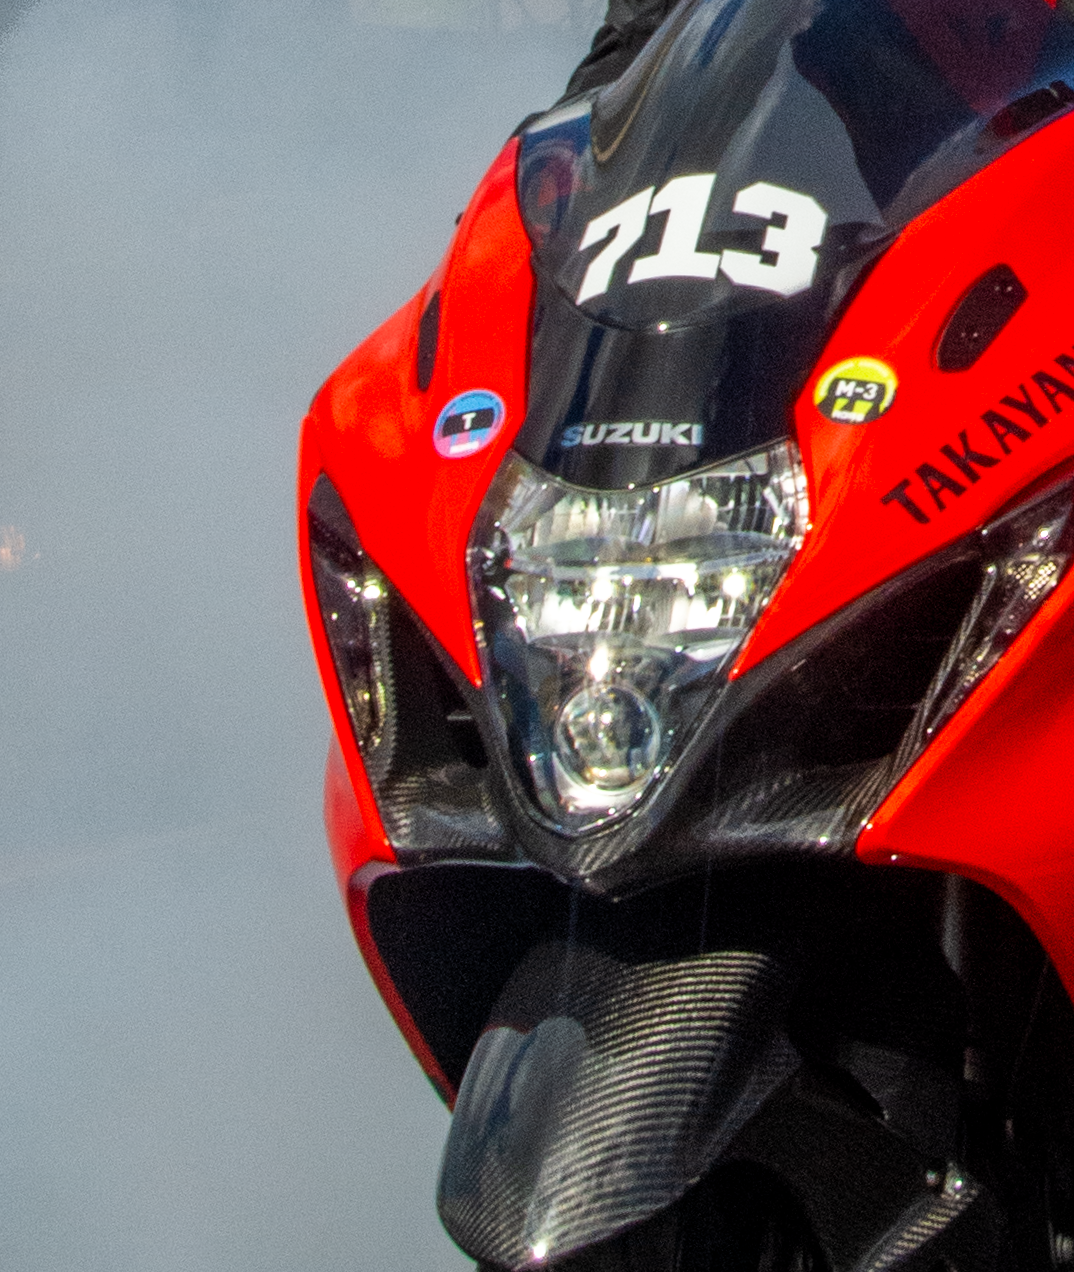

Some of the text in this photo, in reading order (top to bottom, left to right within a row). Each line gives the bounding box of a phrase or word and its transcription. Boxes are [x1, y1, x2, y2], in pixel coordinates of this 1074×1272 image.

[577, 172, 828, 303] 713
[835, 380, 878, 400] M-3
[462, 412, 477, 430] T
[561, 422, 704, 447] SUZUKI
